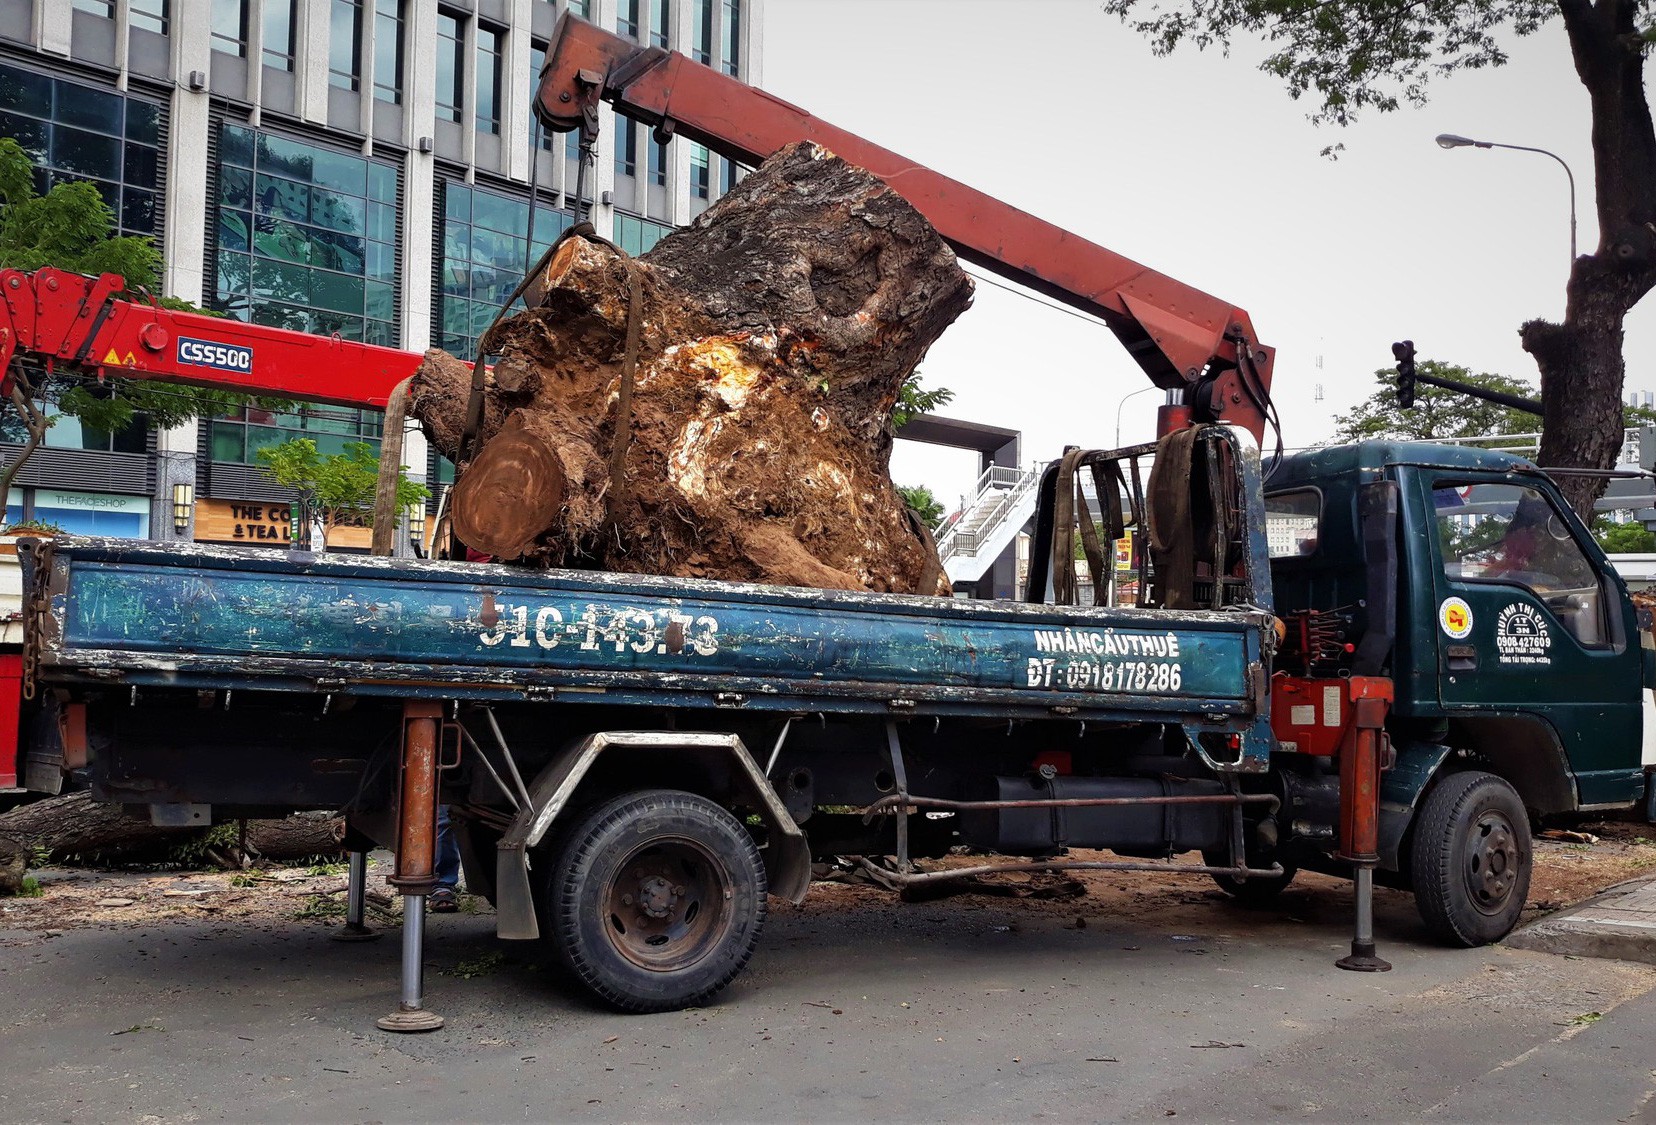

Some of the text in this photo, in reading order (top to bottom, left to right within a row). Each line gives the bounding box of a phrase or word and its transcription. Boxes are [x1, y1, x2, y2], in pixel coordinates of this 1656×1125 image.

[181, 342, 250, 369] CSS500
[230, 504, 263, 520] THE
[233, 524, 245, 537] &
[247, 524, 278, 539] TEA
